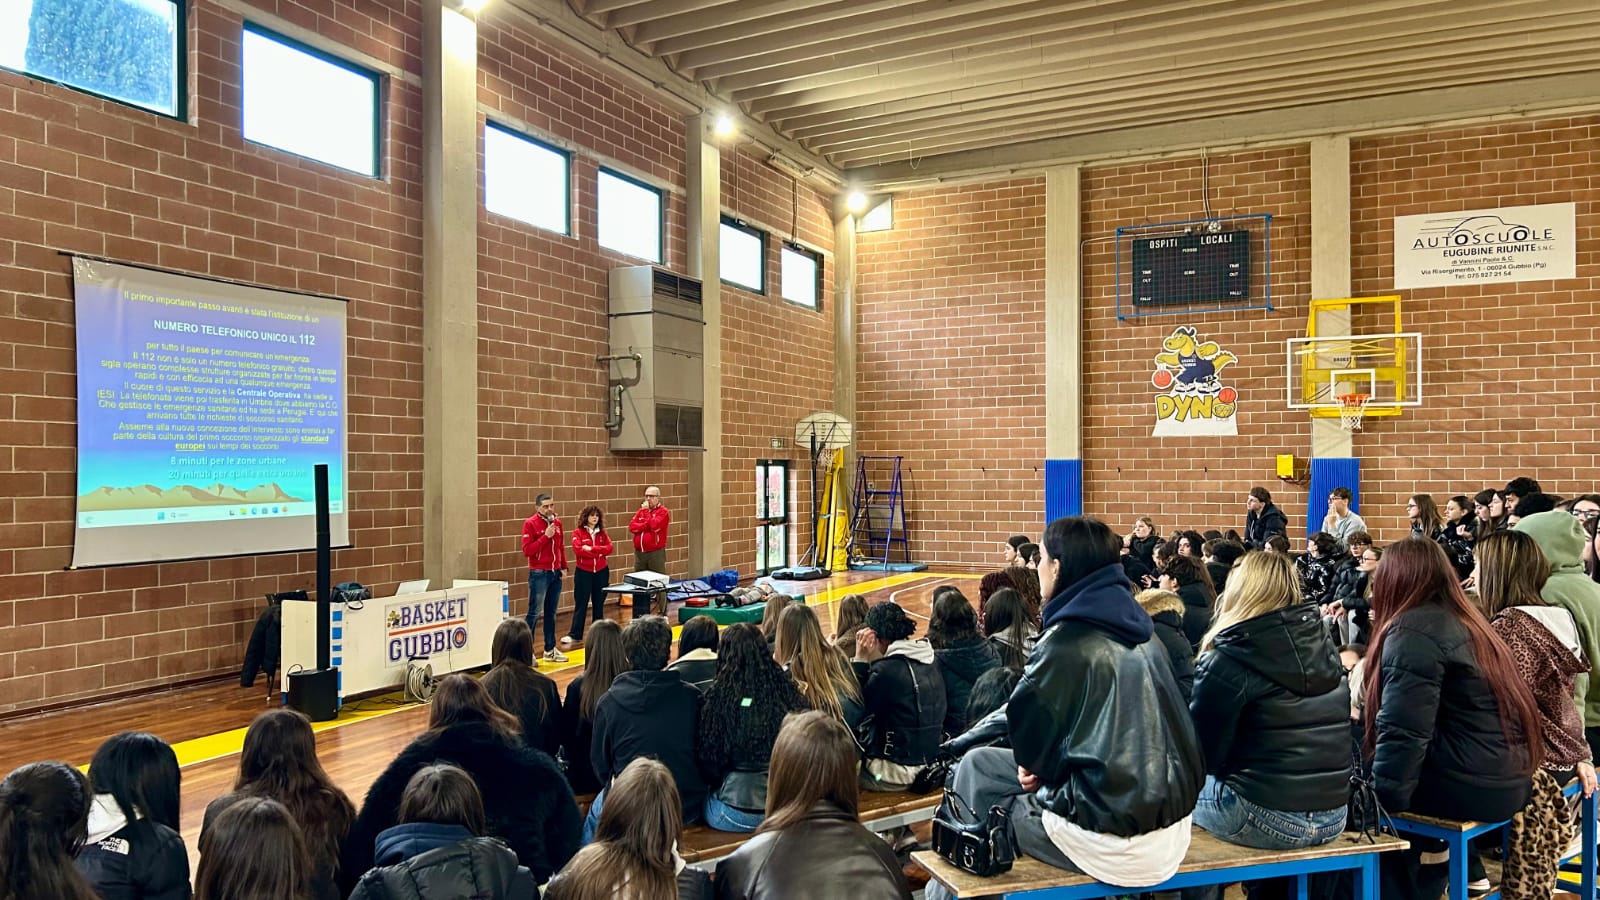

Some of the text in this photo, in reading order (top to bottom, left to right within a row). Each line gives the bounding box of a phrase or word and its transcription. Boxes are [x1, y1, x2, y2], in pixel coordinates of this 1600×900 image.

[1149, 238, 1178, 249] OSPITI
[1200, 233, 1233, 245] LOCALI
[1412, 228, 1553, 250] AUTOSCUOLE
[1442, 246, 1494, 257] EUGUBINE
[1496, 243, 1536, 254] RIUNITE
[1508, 261, 1532, 270] Gubbio
[131, 292, 154, 303] primo
[156, 295, 197, 308] importante
[199, 301, 221, 311] passo
[153, 319, 316, 346] NUMERO TELEFONICO UNICO IL 112
[146, 342, 159, 351] per
[161, 343, 179, 351] tutto
[187, 346, 209, 355] paese
[211, 348, 223, 357] per
[100, 359, 121, 370] sigla
[123, 361, 156, 372] operano
[158, 363, 199, 374] complesse
[141, 352, 155, 360] 112
[157, 354, 172, 362] non
[181, 356, 197, 364] solo
[210, 359, 237, 368] numero
[134, 371, 157, 380] rapidi
[182, 375, 213, 384] efficacia
[214, 376, 224, 384] ad
[120, 390, 130, 399] La
[132, 391, 172, 401] telefonata
[130, 382, 154, 391] cuore
[165, 385, 191, 394] questo
[236, 387, 267, 398] Centrale
[268, 389, 301, 400] Operativa
[98, 399, 117, 409] Che
[118, 402, 152, 412] gestisce
[1156, 395, 1236, 422] DYNO
[118, 422, 154, 431] Assieme
[113, 431, 135, 441] parte
[136, 432, 157, 440] della
[158, 432, 185, 441] cultura
[301, 433, 329, 443] standard
[179, 456, 208, 466] minuti
[210, 457, 225, 468] per
[226, 456, 235, 465] le
[237, 457, 256, 466] zone
[257, 456, 287, 466] urbane
[401, 598, 467, 627] BASKET
[389, 627, 467, 661] GUBBIO
